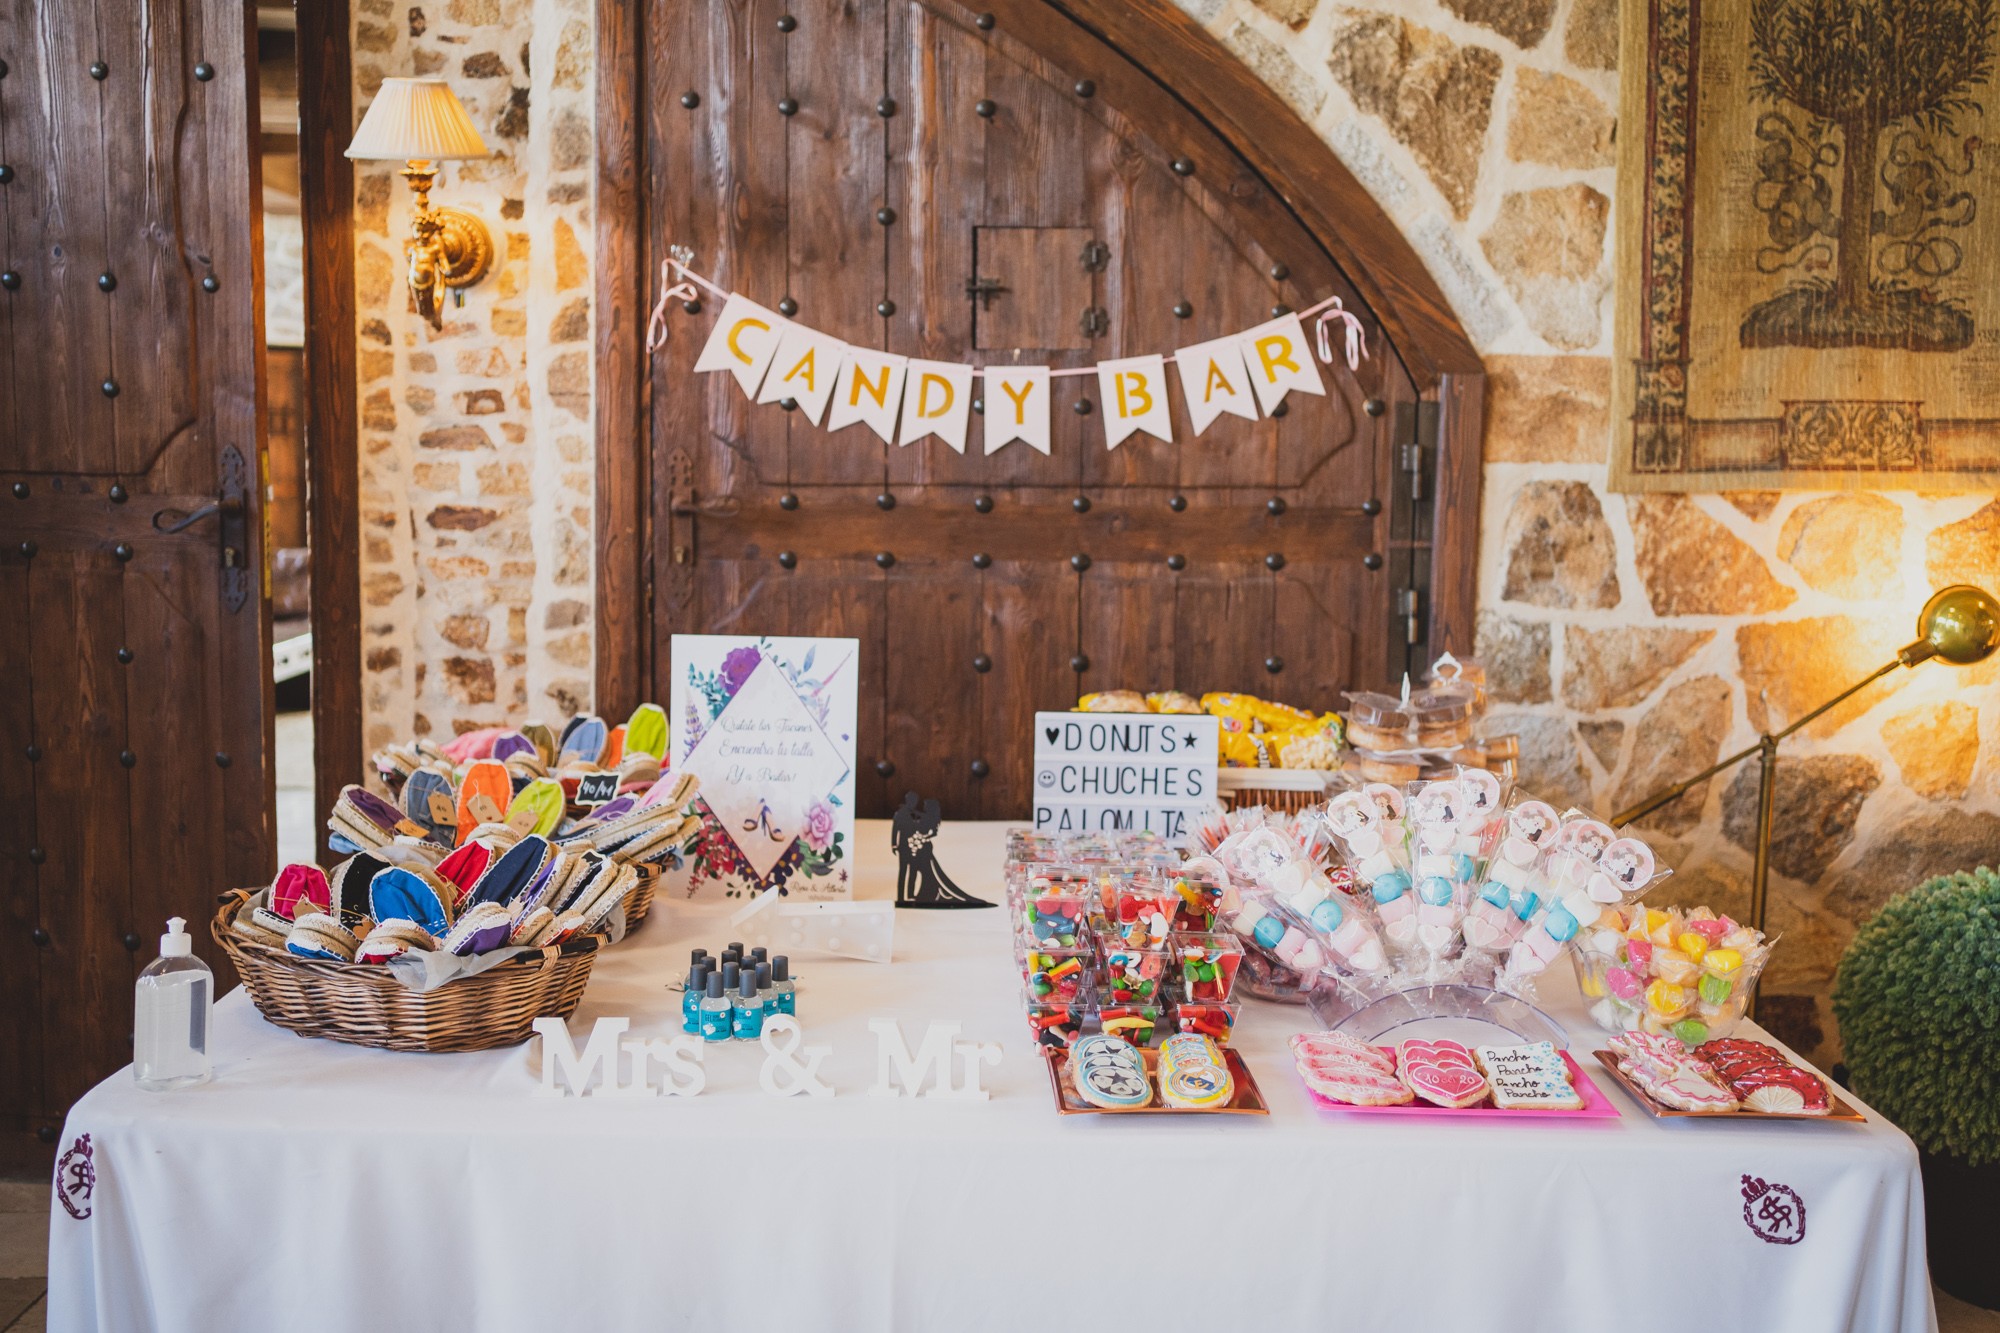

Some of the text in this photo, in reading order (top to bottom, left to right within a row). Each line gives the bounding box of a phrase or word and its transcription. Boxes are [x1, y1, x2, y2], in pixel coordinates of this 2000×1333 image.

[726, 316, 1301, 426] CANDY BAR
[1064, 722, 1177, 753] DONUTS
[1060, 765, 1203, 797] CHUCHES
[1036, 807, 1208, 839] PALOMITA
[531, 1012, 1005, 1101] Mrs & Mr
[1486, 1049, 1531, 1063] Pancho
[1459, 1074, 1476, 1085] 20
[1496, 1063, 1544, 1076] Pancho
[1495, 1076, 1541, 1088] Pancho
[1503, 1088, 1551, 1098] Pancho
